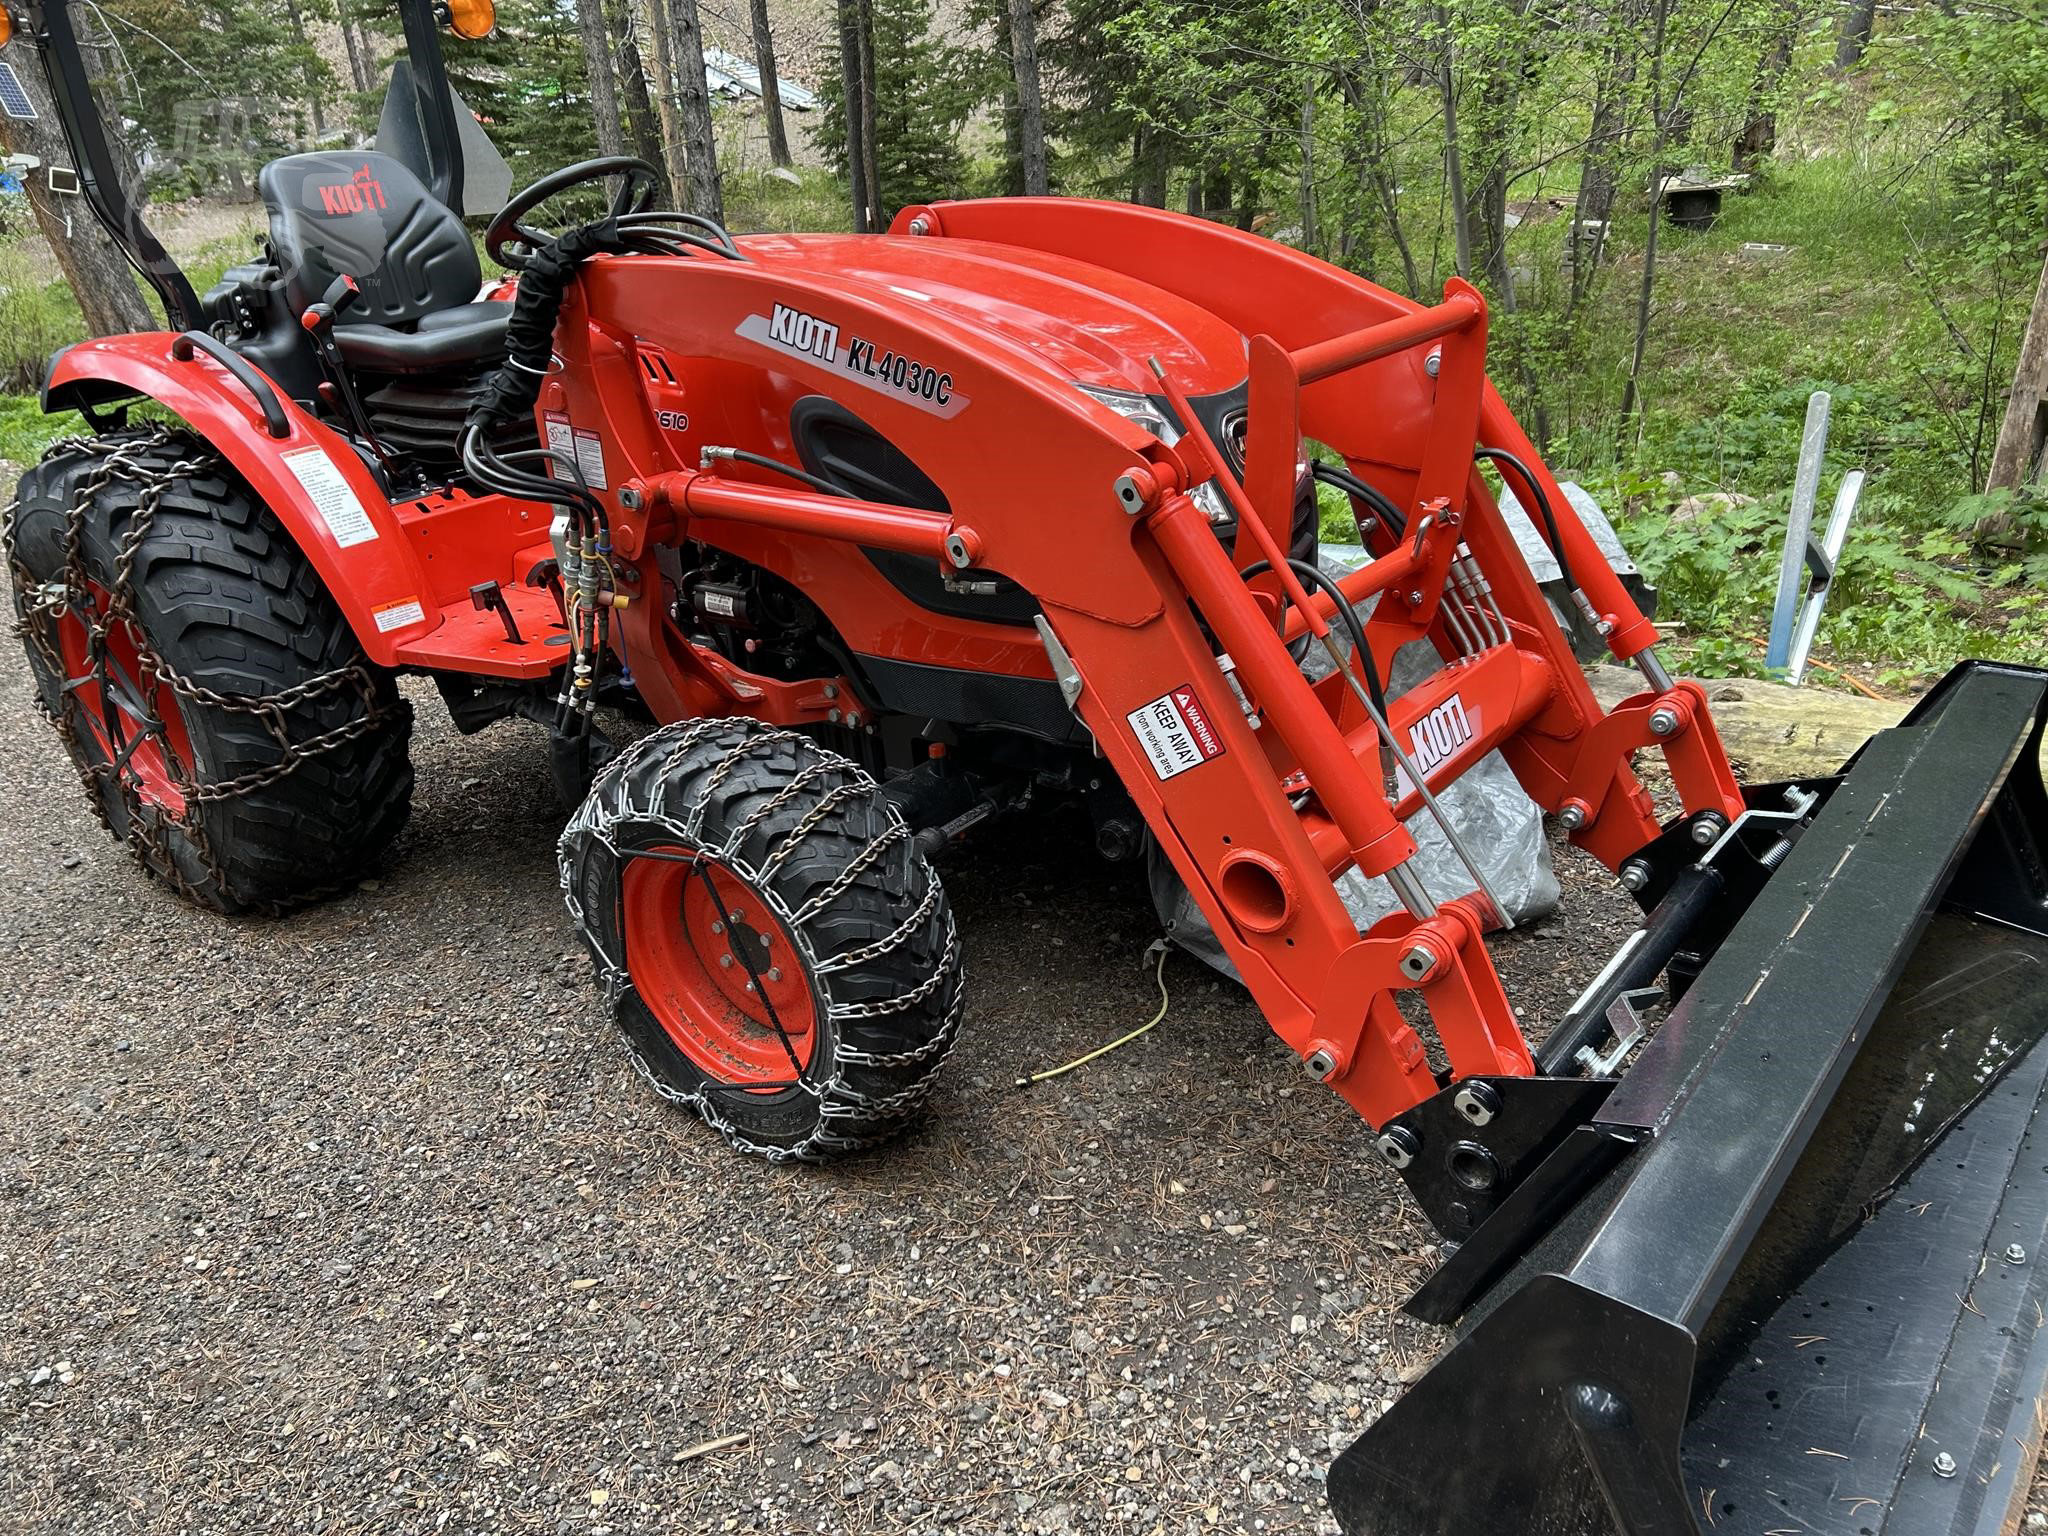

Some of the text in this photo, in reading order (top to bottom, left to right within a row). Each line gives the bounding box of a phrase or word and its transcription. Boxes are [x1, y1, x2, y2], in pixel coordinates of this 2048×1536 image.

[319, 180, 387, 215] KIOTI
[769, 302, 953, 407] KIOTI KL4030C
[1136, 711, 1174, 774] from working area
[1151, 700, 1197, 764] KEEP AWAY
[1186, 705, 1218, 754] WARNING
[1408, 691, 1473, 775] KIOTI
